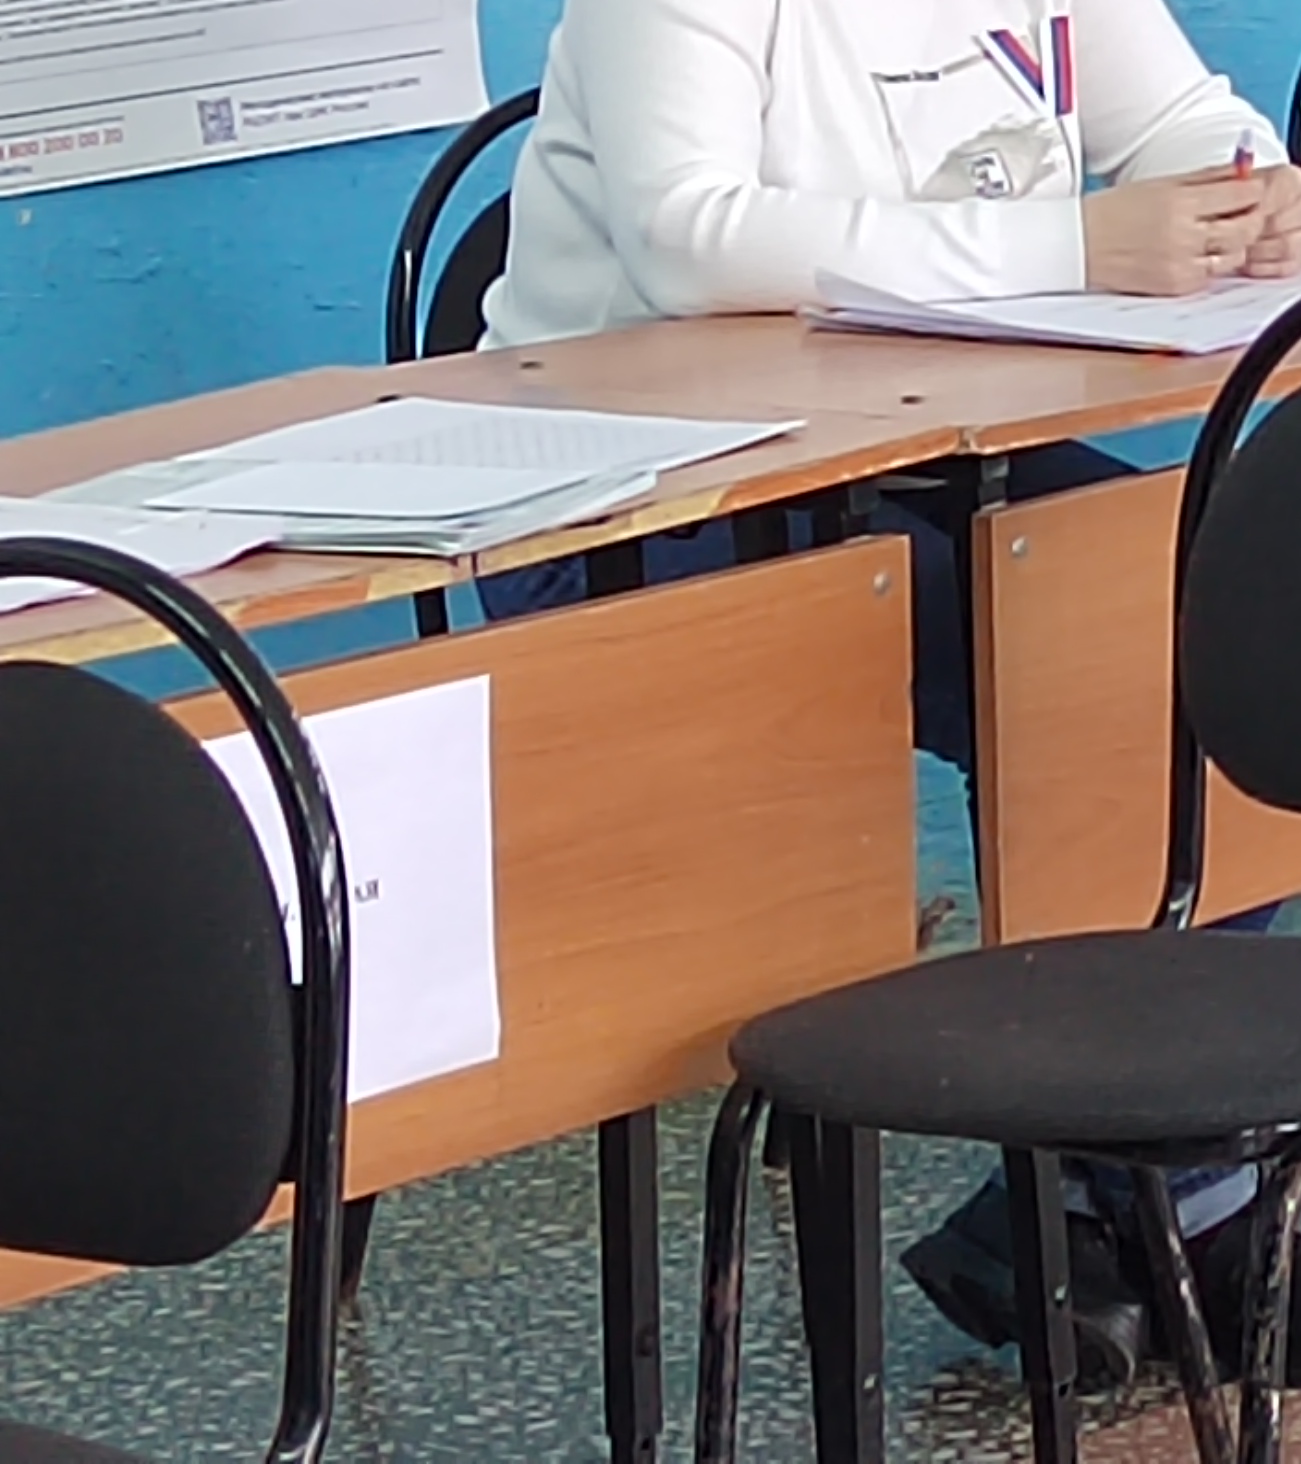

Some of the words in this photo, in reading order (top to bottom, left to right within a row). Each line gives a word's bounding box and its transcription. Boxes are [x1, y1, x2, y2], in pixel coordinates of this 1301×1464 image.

[9, 141, 39, 158] 800
[44, 136, 73, 154] 200
[79, 131, 99, 147] 00
